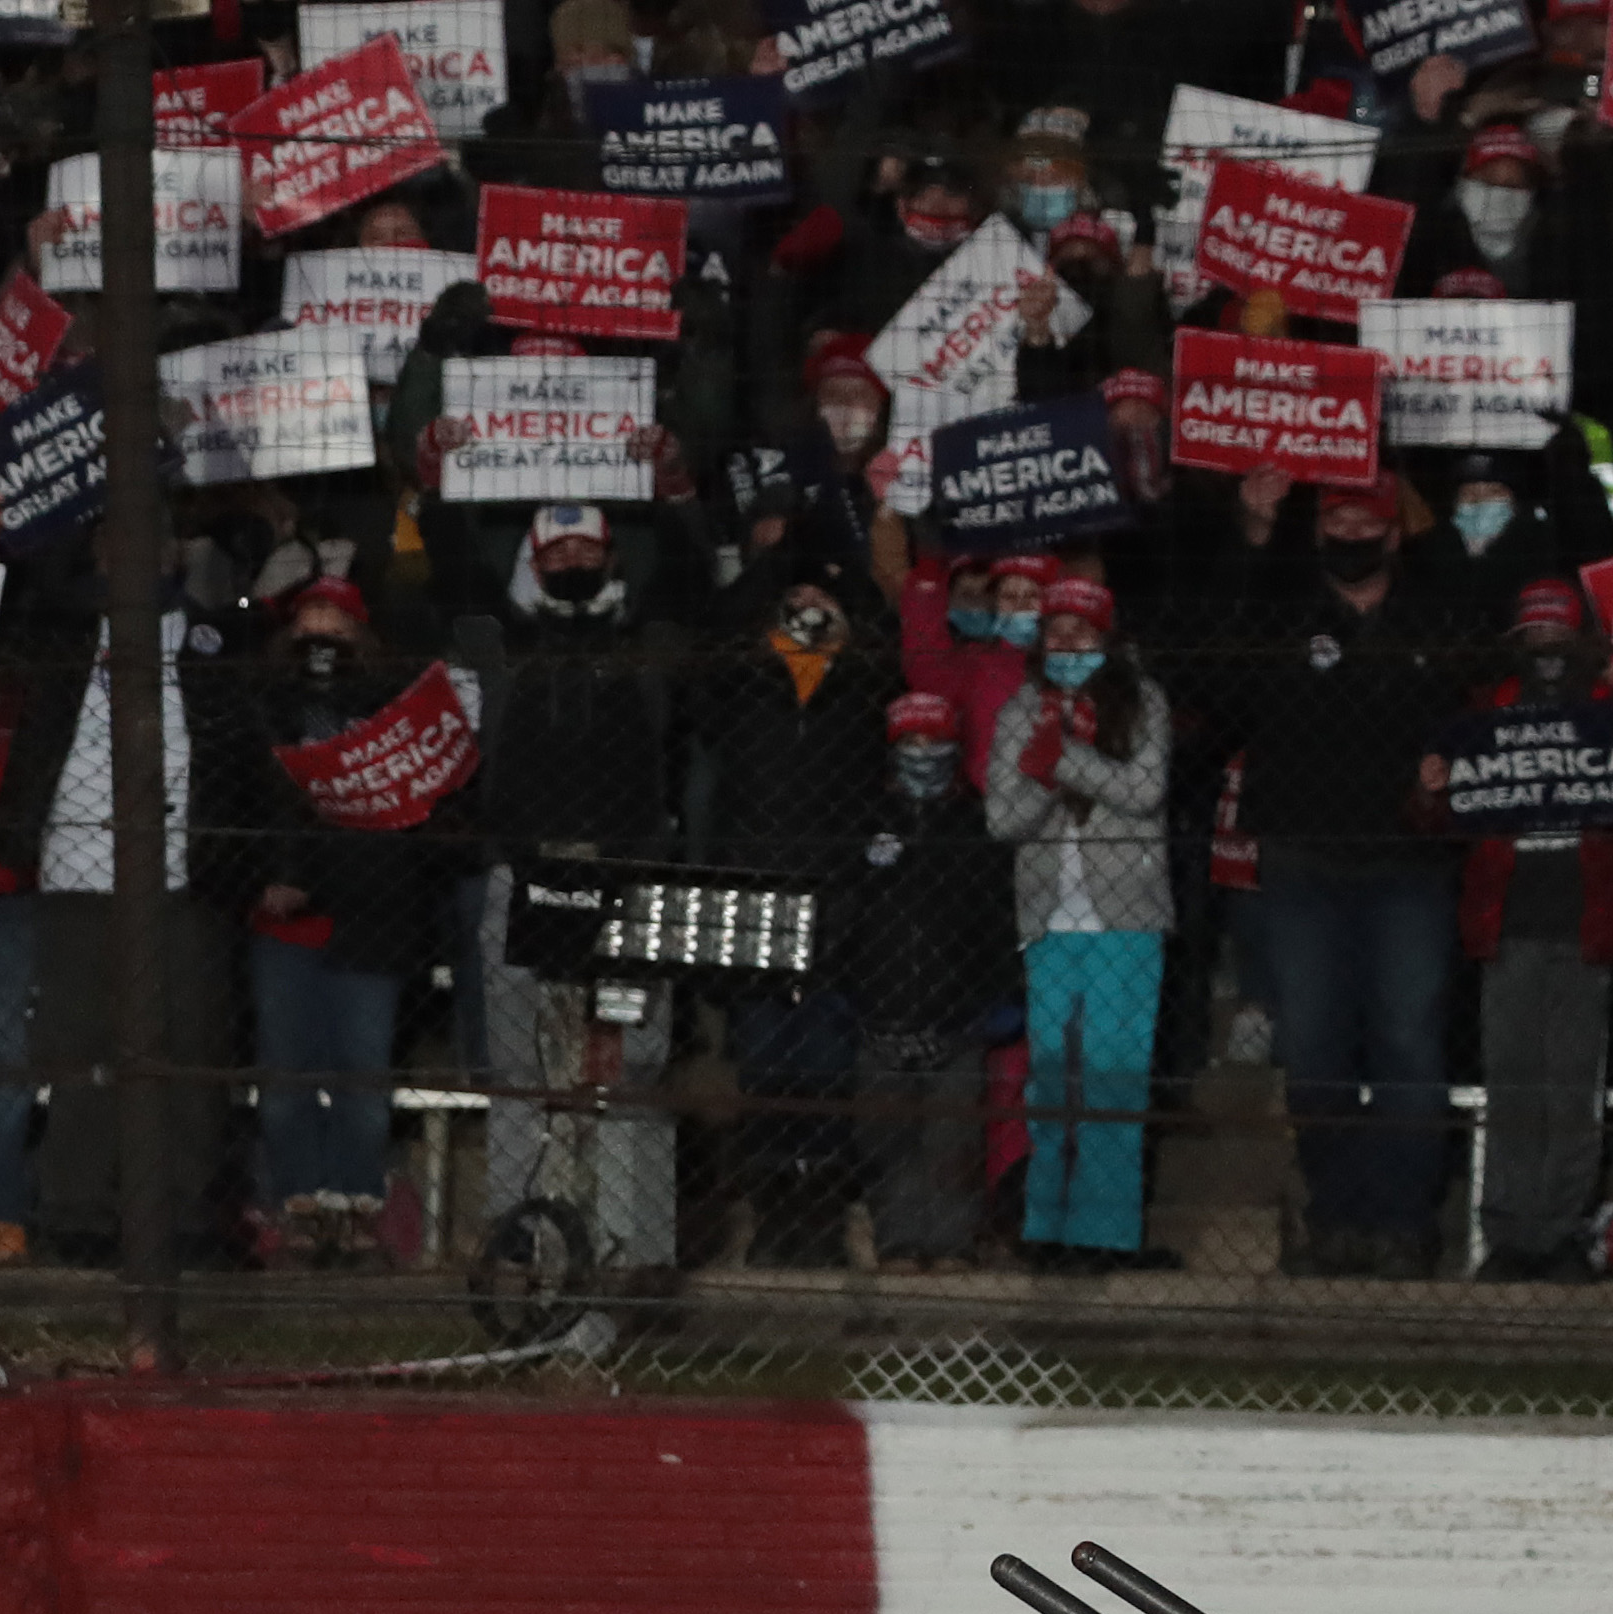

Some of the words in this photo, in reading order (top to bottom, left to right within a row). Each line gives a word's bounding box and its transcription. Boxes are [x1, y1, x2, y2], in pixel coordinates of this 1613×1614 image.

[541, 215, 624, 240] MAKE
[1266, 193, 1348, 229] MAKE
[487, 237, 671, 283] AMERICA
[1208, 206, 1388, 278] AMERICA
[1203, 234, 1290, 285] GREAT
[1292, 272, 1383, 300] AGAIN
[485, 274, 574, 304] GREAT
[581, 284, 670, 309] AGAIN
[509, 381, 586, 401] MAKE
[1233, 359, 1317, 388] MAKE
[11, 396, 84, 443] MAKE
[463, 412, 638, 439] AMERICA
[1181, 380, 1369, 430] AMERICA
[455, 447, 548, 469] GREAT
[554, 442, 641, 468] AGAIN
[1180, 415, 1270, 450] GREAT
[1274, 430, 1369, 461] AGAIN
[1, 480, 81, 530] GREAT
